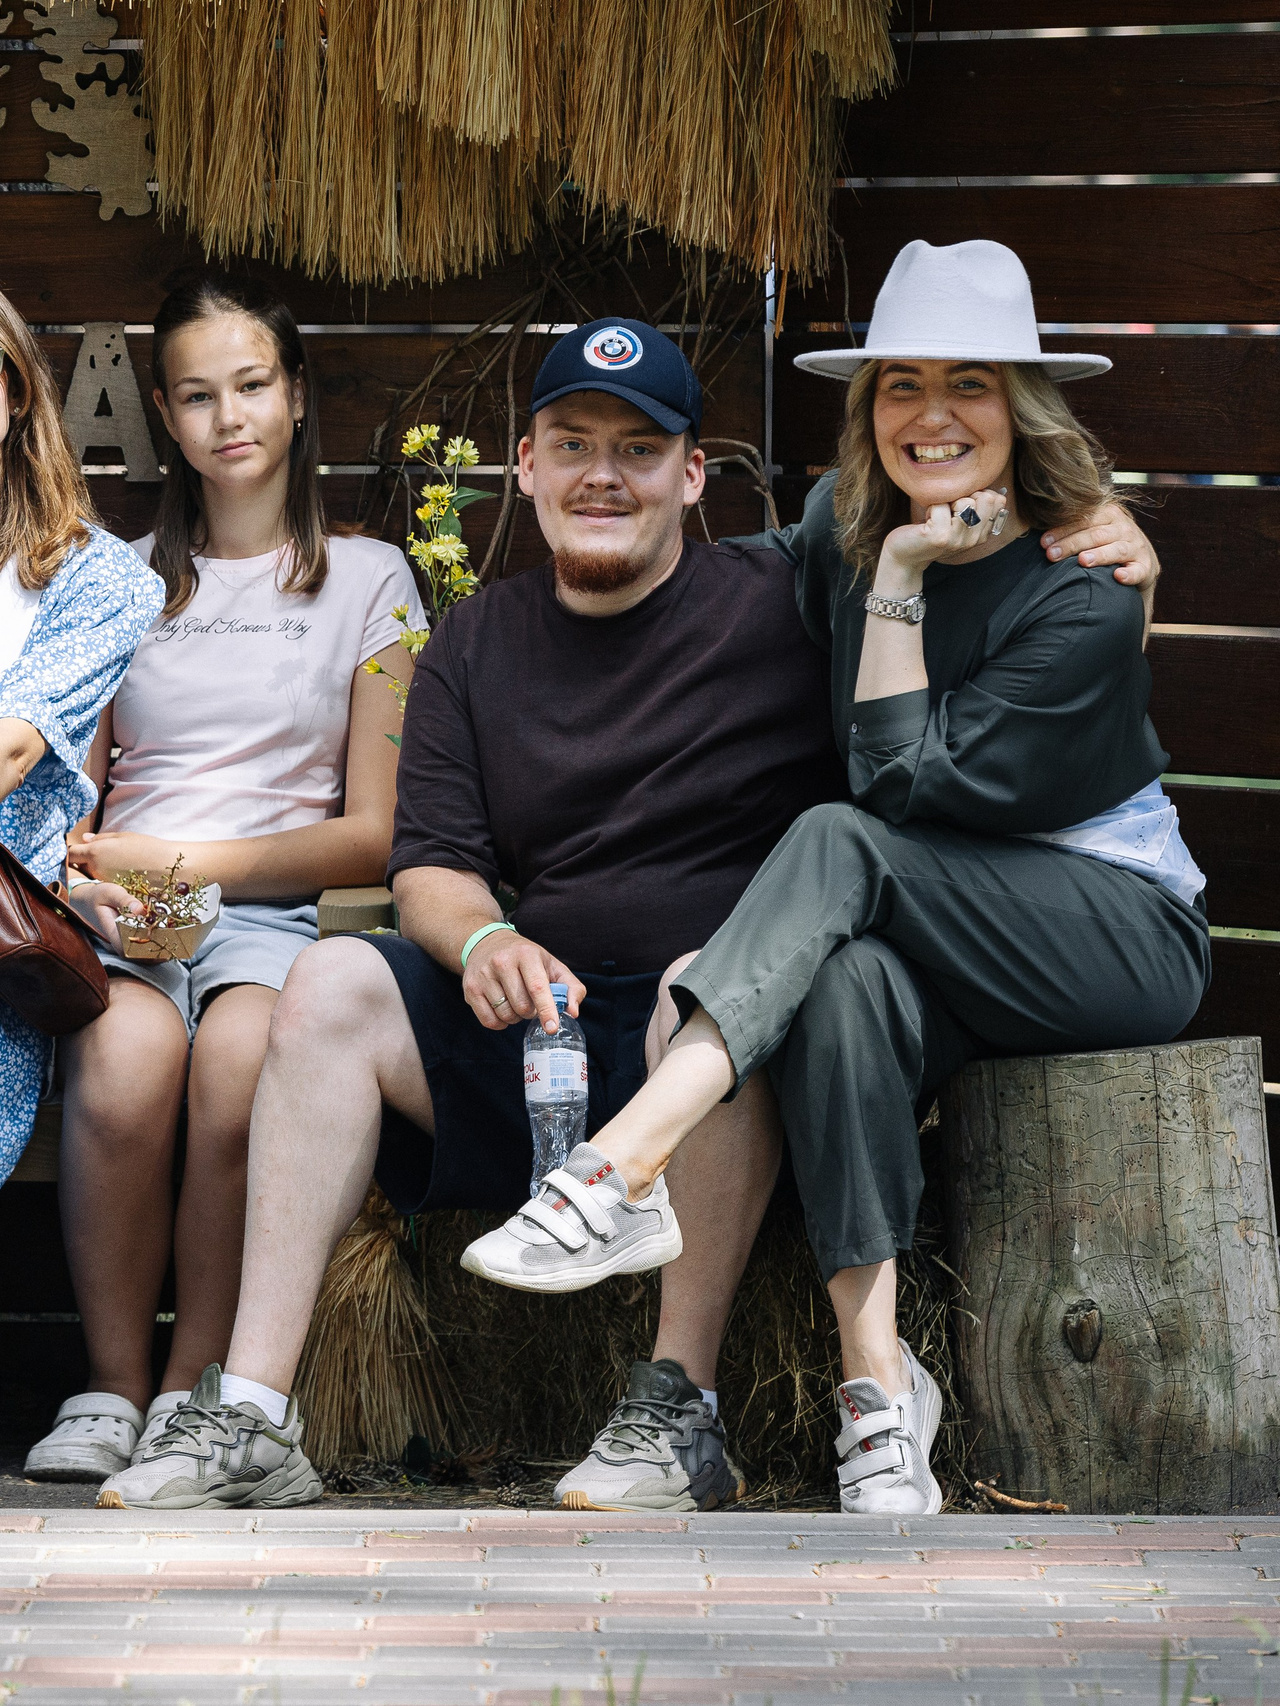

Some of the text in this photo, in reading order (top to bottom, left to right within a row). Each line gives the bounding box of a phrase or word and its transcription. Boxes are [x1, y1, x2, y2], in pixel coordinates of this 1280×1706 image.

[178, 617, 222, 642] God
[214, 617, 272, 634] Knows
[276, 616, 312, 640] Why
